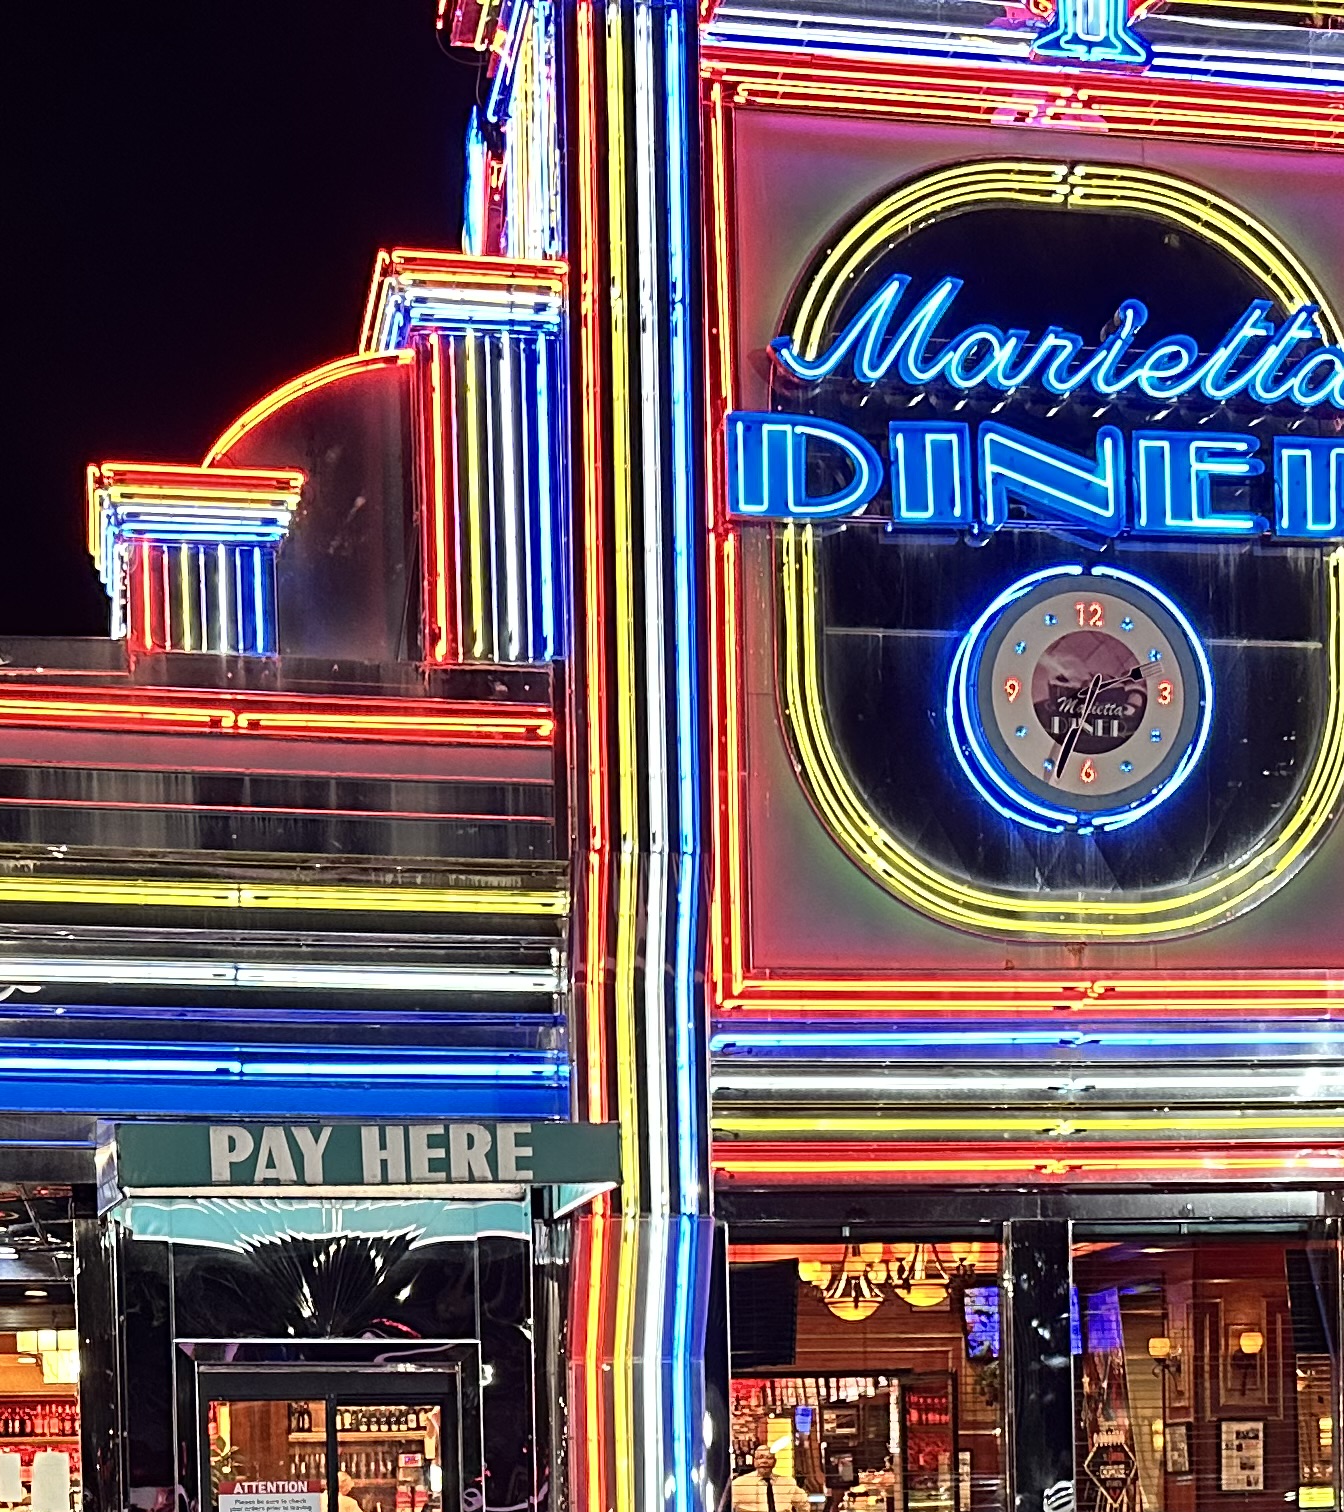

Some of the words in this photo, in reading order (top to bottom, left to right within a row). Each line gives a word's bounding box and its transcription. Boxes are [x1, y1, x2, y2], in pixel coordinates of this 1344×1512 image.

[1075, 602, 1104, 627] 12
[1005, 677, 1021, 702] 9
[1157, 681, 1173, 705] 3
[1057, 697, 1123, 717] Maietta
[1080, 759, 1096, 783] 6
[209, 1124, 333, 1184] PAY
[361, 1123, 534, 1182] HERE
[234, 1481, 308, 1494] ATTENTION
